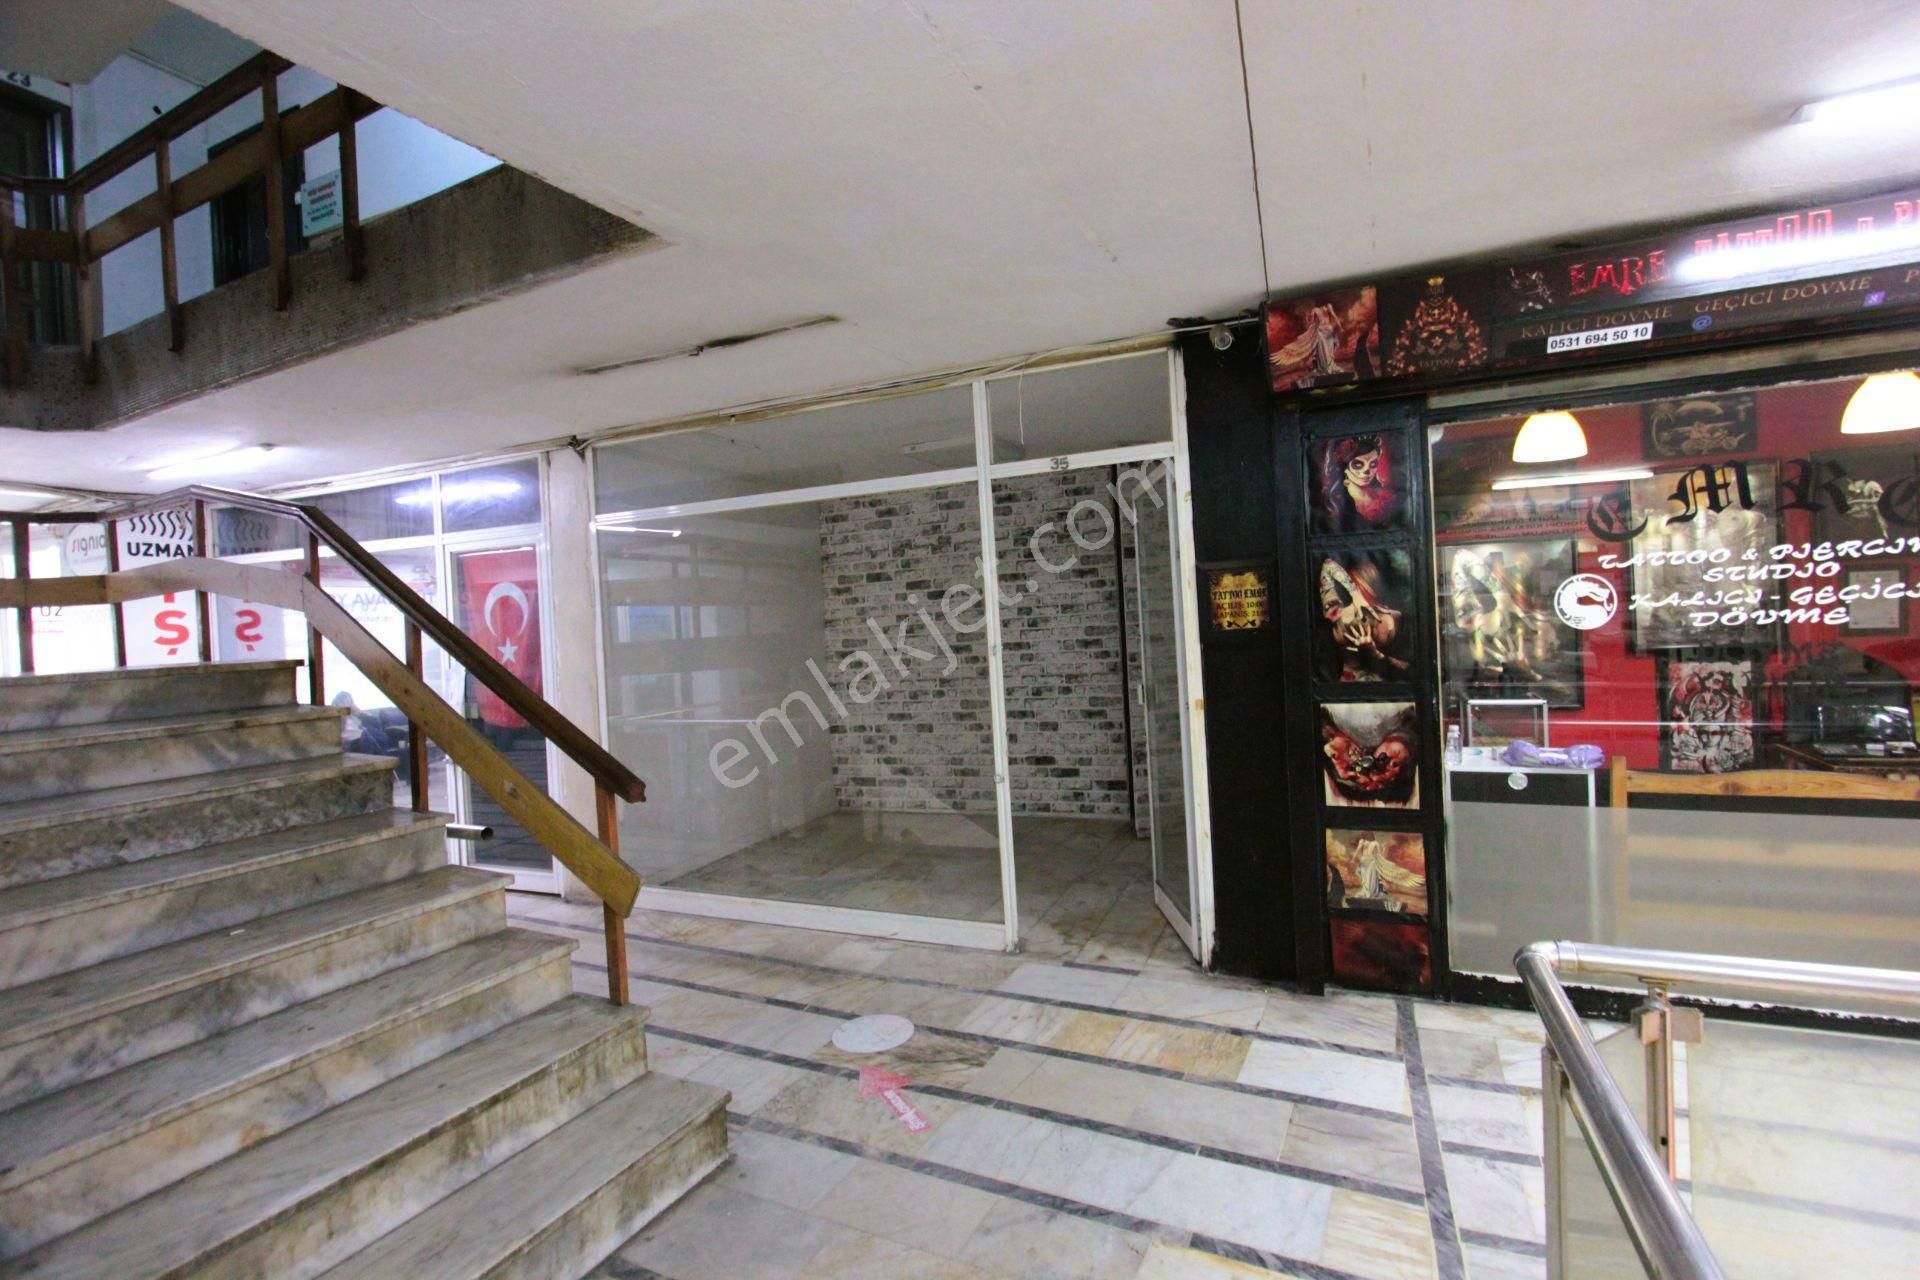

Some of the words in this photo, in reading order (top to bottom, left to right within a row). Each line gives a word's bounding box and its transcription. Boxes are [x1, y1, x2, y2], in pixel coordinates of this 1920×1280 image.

[1568, 250, 1671, 297] EMRE
[1550, 336, 1580, 350] 0531
[1585, 332, 1608, 345] 694
[1612, 330, 1628, 341] 50
[1633, 327, 1649, 338] 10
[1050, 456, 1069, 470] 35
[1598, 548, 1731, 569] TATTOO
[1741, 548, 1759, 560] &
[1703, 561, 1841, 583] STUDIO
[1628, 587, 1763, 611] KALICI
[1689, 606, 1850, 627] DÖVME
